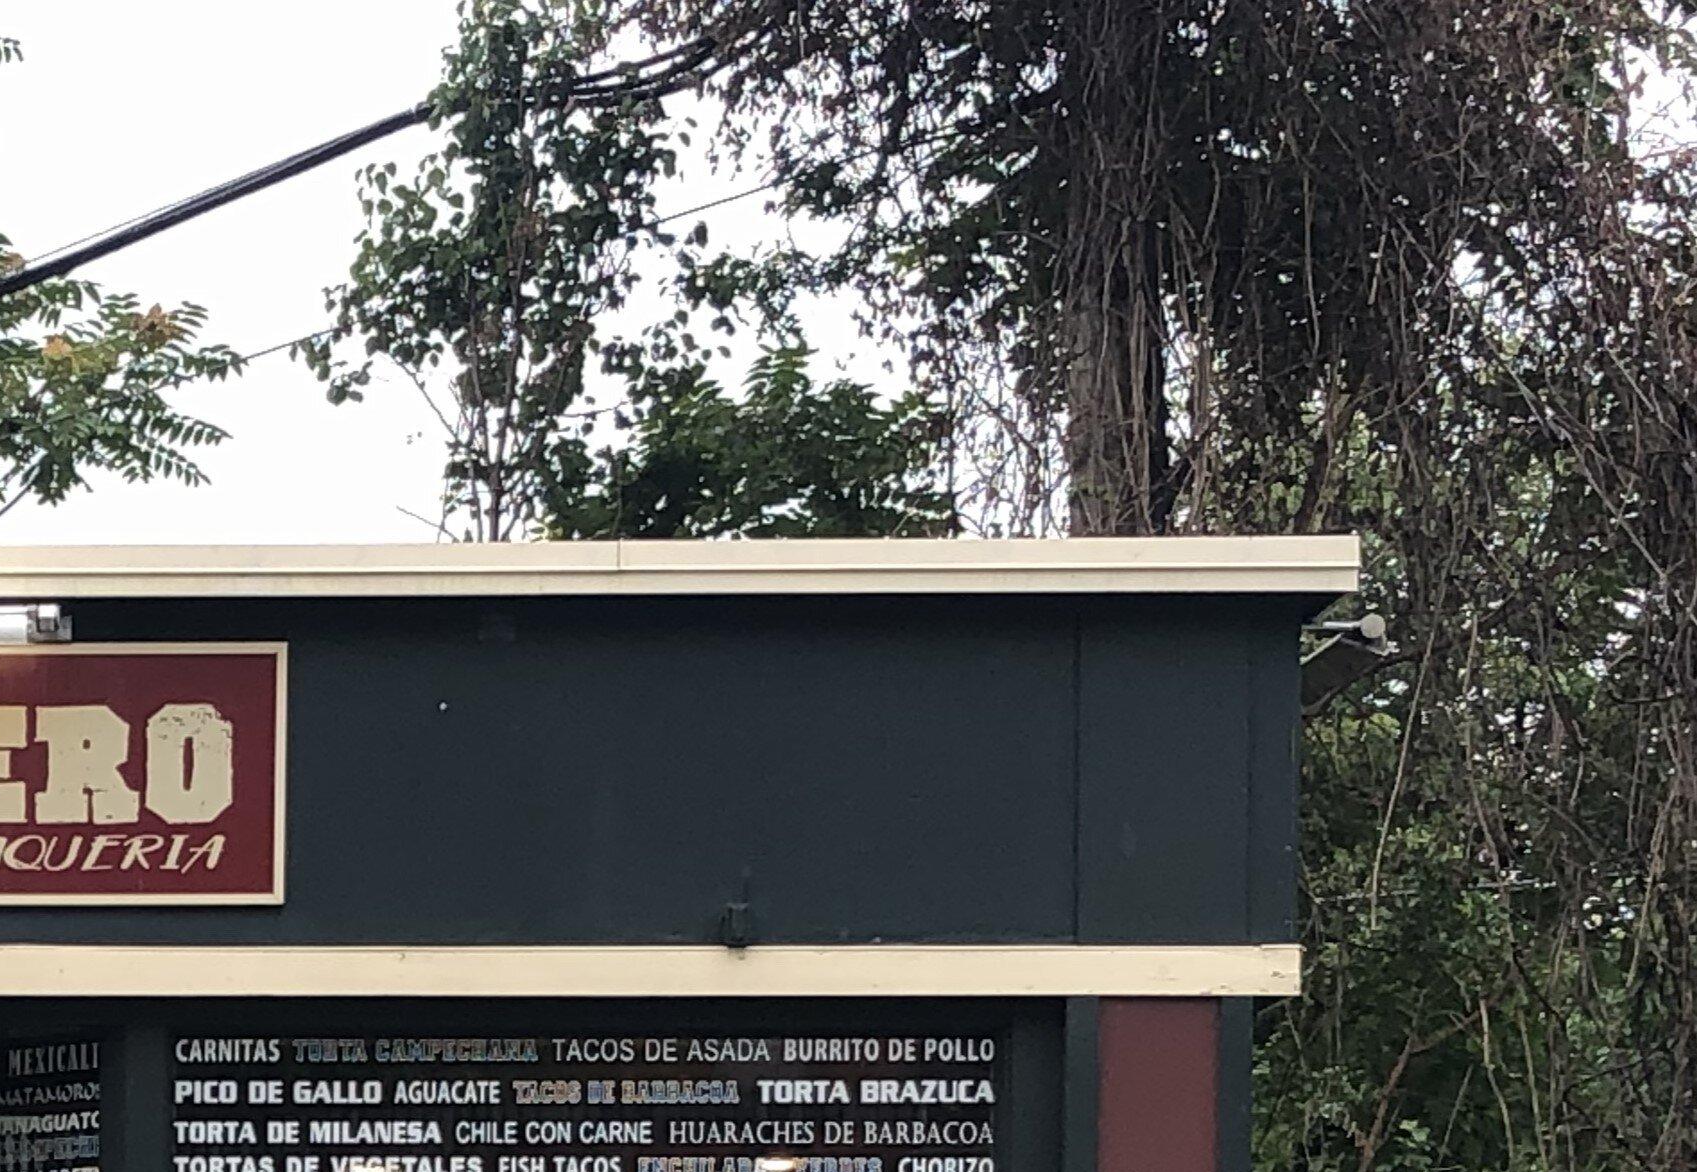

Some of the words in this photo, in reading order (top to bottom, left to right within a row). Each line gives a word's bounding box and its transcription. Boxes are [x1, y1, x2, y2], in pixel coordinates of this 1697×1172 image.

[8, 1042, 99, 1076] MEXICALI
[175, 1038, 281, 1063] CARNITAS
[292, 1038, 368, 1063] TORTA
[375, 1038, 539, 1063] CAMPECHANA
[553, 1038, 634, 1063] TACOS
[645, 1038, 677, 1063] DE
[687, 1038, 771, 1063] ASADA
[783, 1038, 880, 1063] BURRITO
[888, 1038, 916, 1063] DE
[924, 1038, 995, 1063] POLLO
[174, 1079, 238, 1105] PICO
[248, 1079, 284, 1105] DE
[293, 1079, 382, 1105] GALLO
[394, 1079, 501, 1105] AGUACATE
[513, 1079, 581, 1105] TACOS
[588, 1079, 616, 1105] DE
[622, 1079, 740, 1105] BARBACOA
[757, 1079, 851, 1105] TORTA
[860, 1079, 996, 1105] BRAZUCA
[174, 1121, 257, 1145] TORTA
[267, 1121, 300, 1145] DE
[309, 1121, 442, 1145] MILANESA
[455, 1121, 517, 1145] CHILE
[525, 1121, 571, 1145] CON
[579, 1121, 653, 1145] CARNE
[668, 1121, 815, 1145] HUARACHES
[824, 1121, 854, 1145] DE
[863, 1121, 994, 1145] BARBACOA
